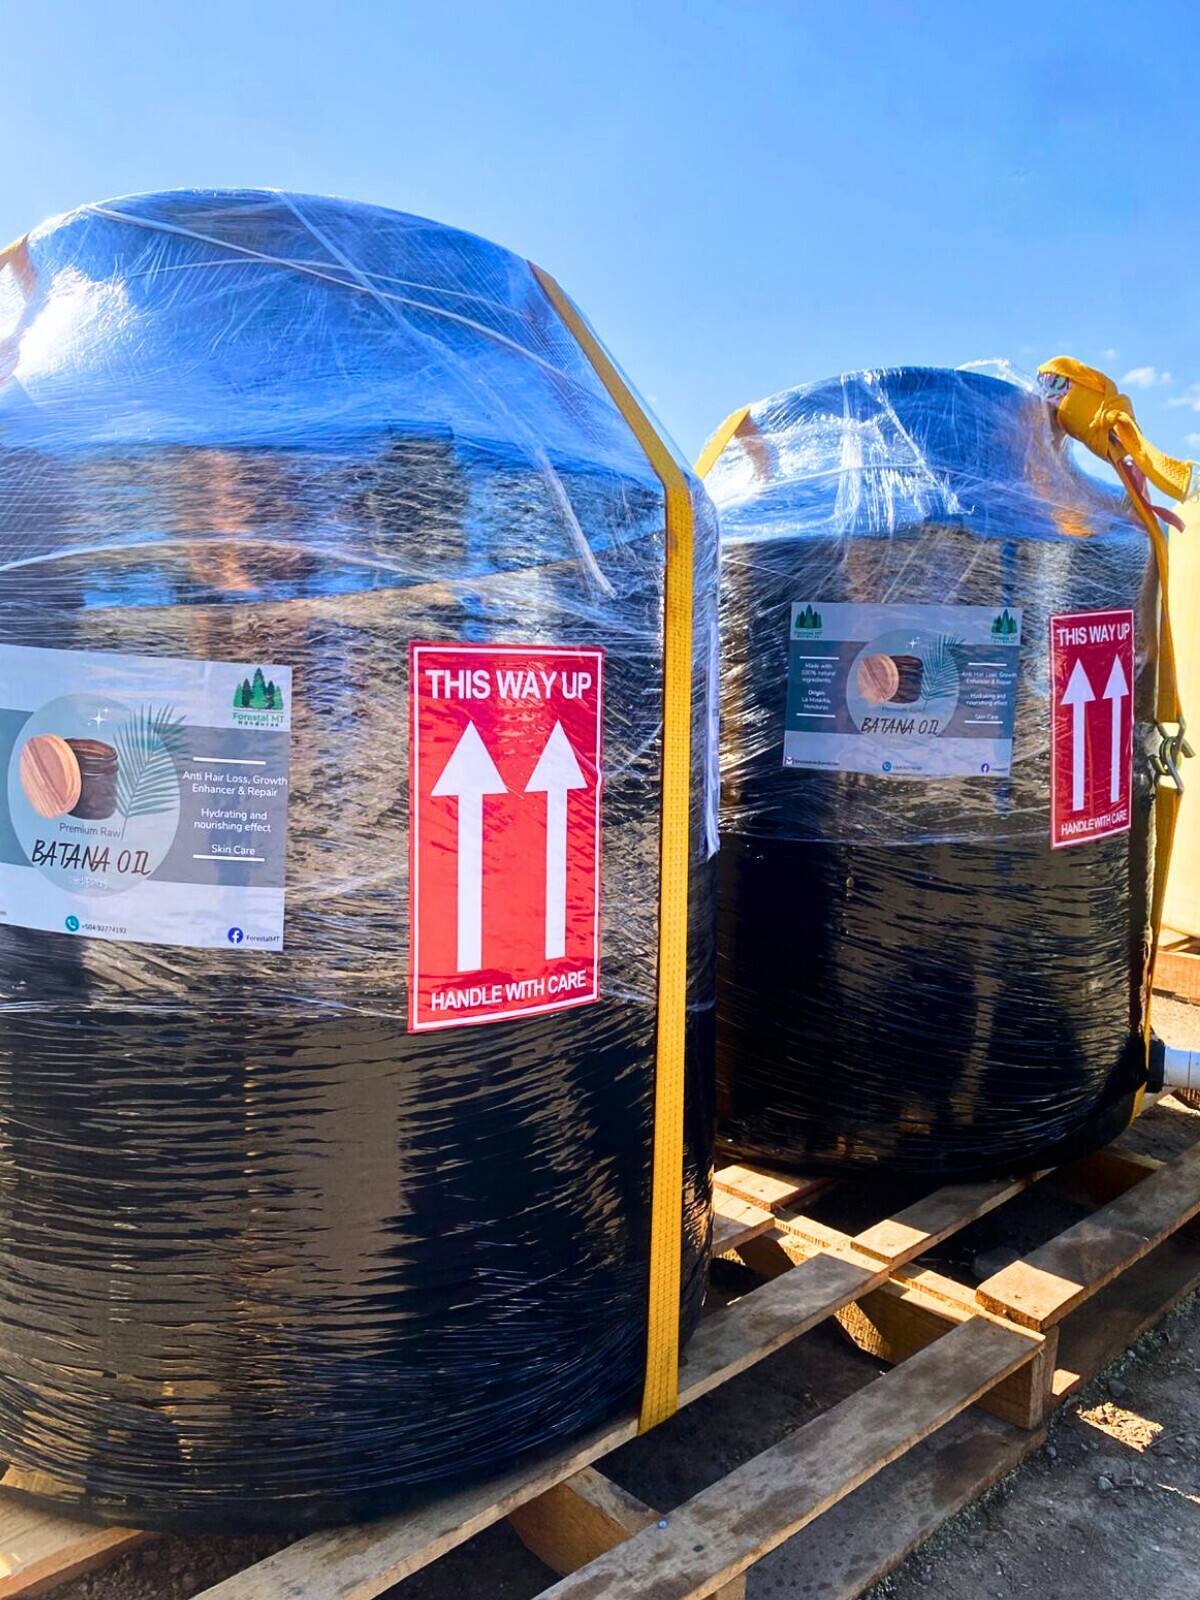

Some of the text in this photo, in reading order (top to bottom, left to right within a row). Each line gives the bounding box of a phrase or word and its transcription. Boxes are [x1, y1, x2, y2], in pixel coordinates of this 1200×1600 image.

[1056, 623, 1130, 646] THIS WAY UP
[425, 669, 592, 699] THIS WAY UP
[232, 712, 284, 723] Forestal MT
[861, 717, 940, 735] BATANA OIL
[183, 771, 288, 786] Anti Hair Loss, Growth
[192, 783, 278, 798] Enhancer & Repair
[201, 808, 267, 821] Hydrating and
[1061, 809, 1127, 836] HANDLE WITH CARE
[59, 822, 121, 838] Premium Raw
[194, 821, 271, 833] nourishing effect
[32, 839, 152, 876] BATANA OIL
[211, 844, 256, 855] Skin Care
[431, 970, 587, 1011] HANDLE WITH CARE
